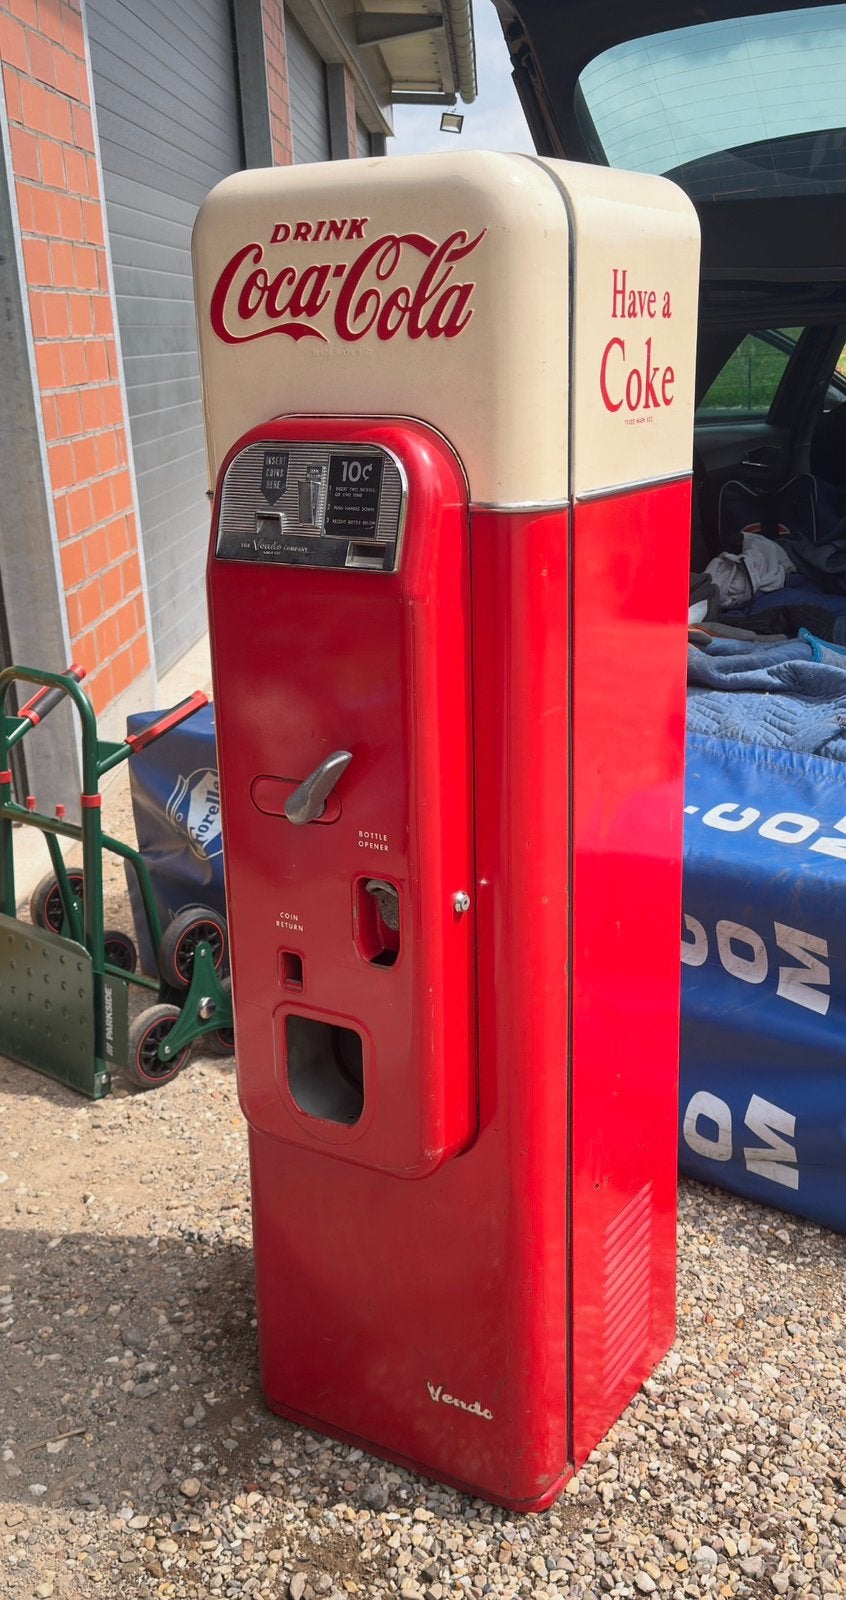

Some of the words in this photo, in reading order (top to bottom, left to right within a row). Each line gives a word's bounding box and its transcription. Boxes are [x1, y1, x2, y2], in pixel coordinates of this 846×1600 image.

[270, 217, 368, 244] DRINK
[210, 228, 488, 345] Coca-Cola
[611, 269, 656, 318] Have
[662, 291, 672, 319] a
[600, 337, 675, 412] Coke
[265, 456, 287, 465] INSERT
[265, 468, 284, 477] COINS
[341, 461, 373, 482] 10¢
[266, 480, 281, 489] HERE
[253, 539, 282, 551] Vendo
[358, 830, 388, 842] BOTTLE
[358, 841, 389, 851] OPENER
[279, 911, 299, 921] COIN
[275, 920, 304, 932] RETURN
[104, 986, 114, 1041] PARKSIDE
[426, 1381, 494, 1420] Vendo
